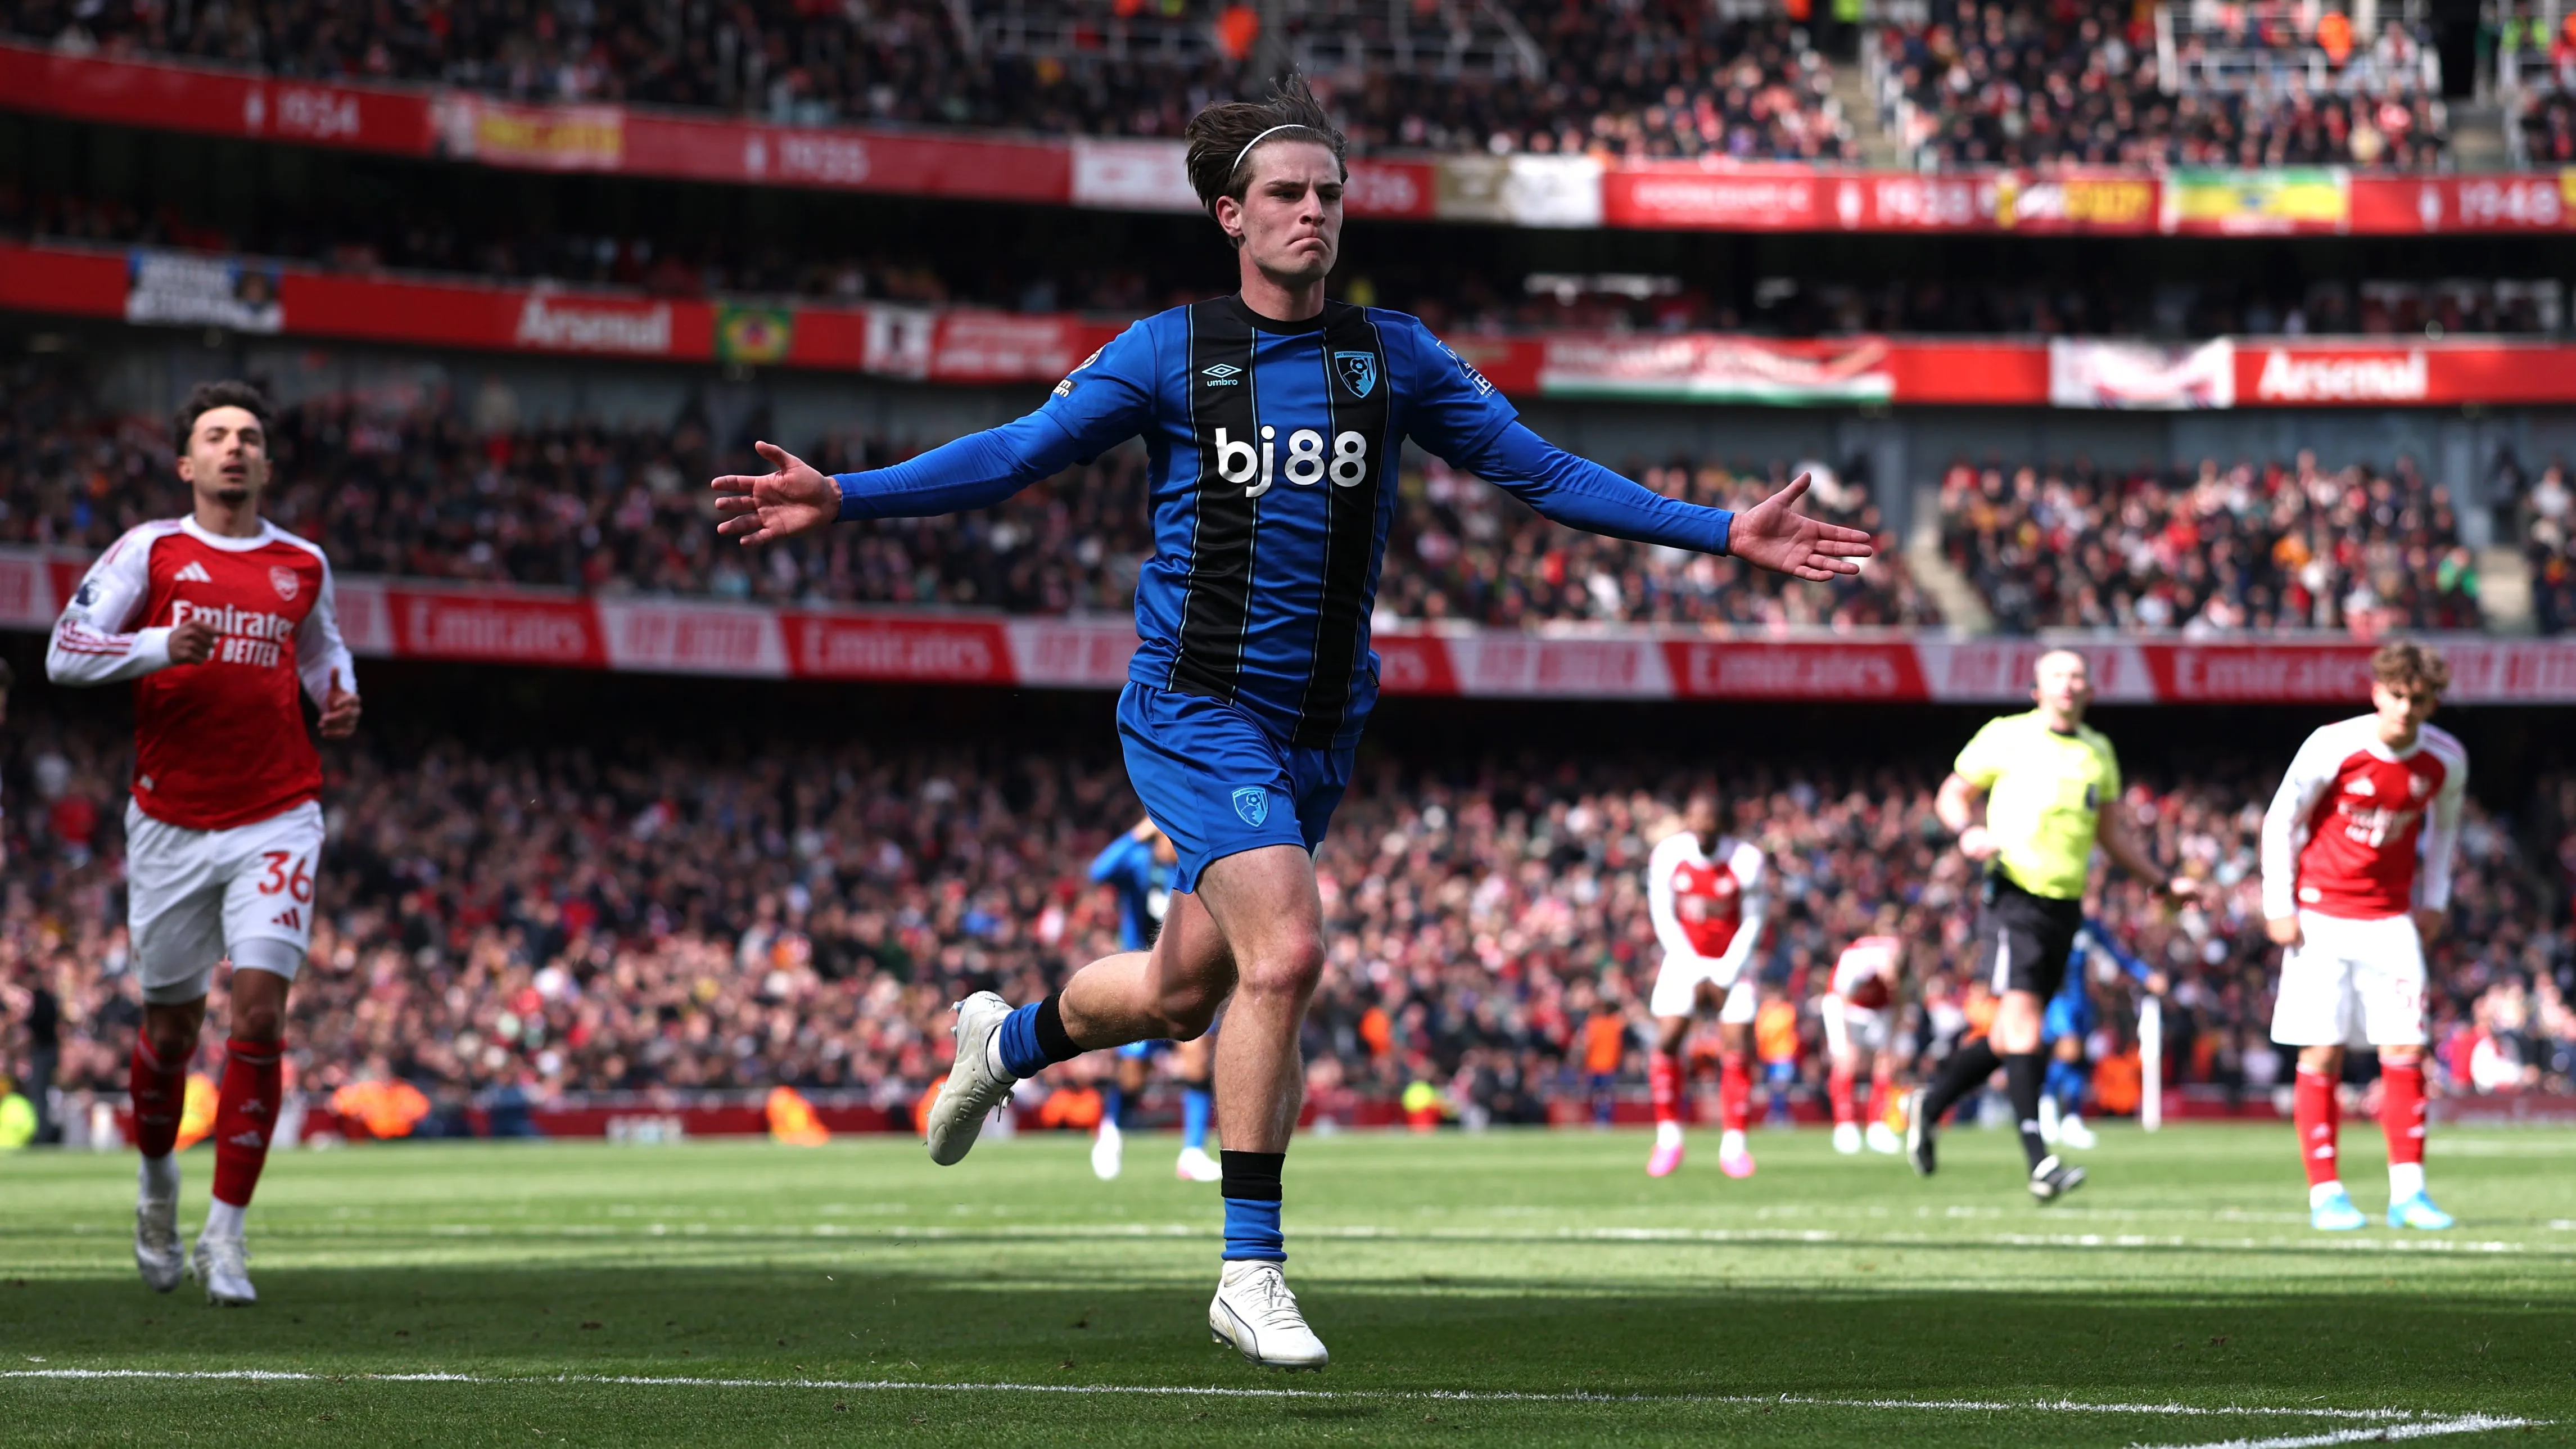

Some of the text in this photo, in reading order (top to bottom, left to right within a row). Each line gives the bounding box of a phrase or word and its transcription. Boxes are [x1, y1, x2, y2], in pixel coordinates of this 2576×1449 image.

[2459, 180, 2561, 226] 1948
[516, 300, 673, 353] Arsenal
[1206, 378, 1238, 387] umbro
[2257, 347, 2428, 401] Arsenal
[1215, 425, 1367, 498] bj88
[171, 599, 295, 643] Emirate
[409, 600, 586, 661] Emirates
[803, 621, 991, 680] Emirates
[1690, 643, 1897, 696] Emirates
[258, 851, 313, 904] 36
